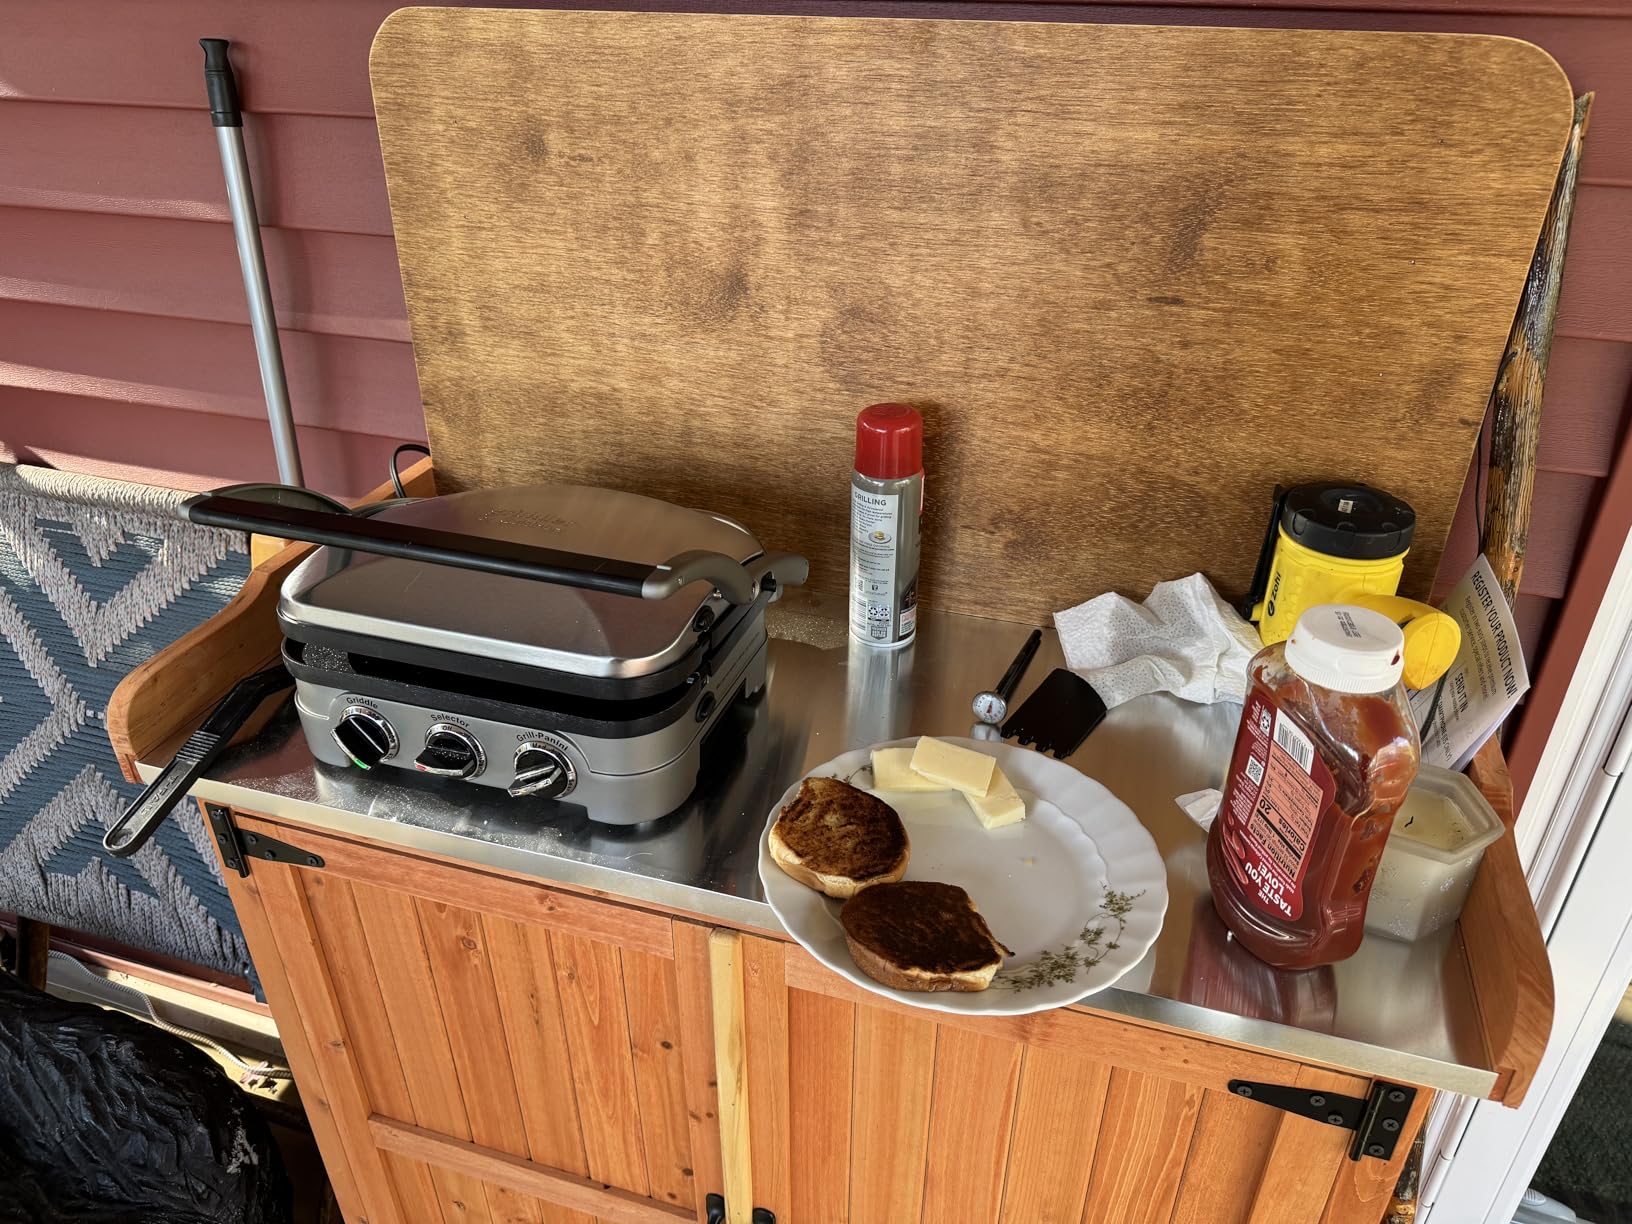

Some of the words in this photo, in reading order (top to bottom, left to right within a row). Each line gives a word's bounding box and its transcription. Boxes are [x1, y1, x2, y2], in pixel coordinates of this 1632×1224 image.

[854, 491, 887, 506] GRILLING
[1470, 570, 1492, 609] REGISTER
[1486, 605, 1501, 634] YOUR
[1492, 629, 1511, 670] PRODUCT
[1455, 672, 1465, 694] SEND
[1502, 668, 1518, 698] NOW!
[346, 697, 378, 709] Griddle
[1457, 691, 1466, 702] IT
[1459, 699, 1468, 712] IN
[430, 714, 471, 728] Selector
[516, 731, 569, 751] Grill-Panini
[1258, 798, 1271, 814] 20
[1249, 823, 1266, 845] Facts
[1277, 817, 1305, 851] Calories
[1277, 838, 1285, 848] size
[1266, 843, 1295, 878] Nutrition
[1284, 847, 1299, 865] Serving
[1244, 861, 1261, 887] YOU
[1257, 861, 1284, 895] LOVE!
[1257, 889, 1268, 904] THE
[1261, 881, 1291, 916] TASTE
